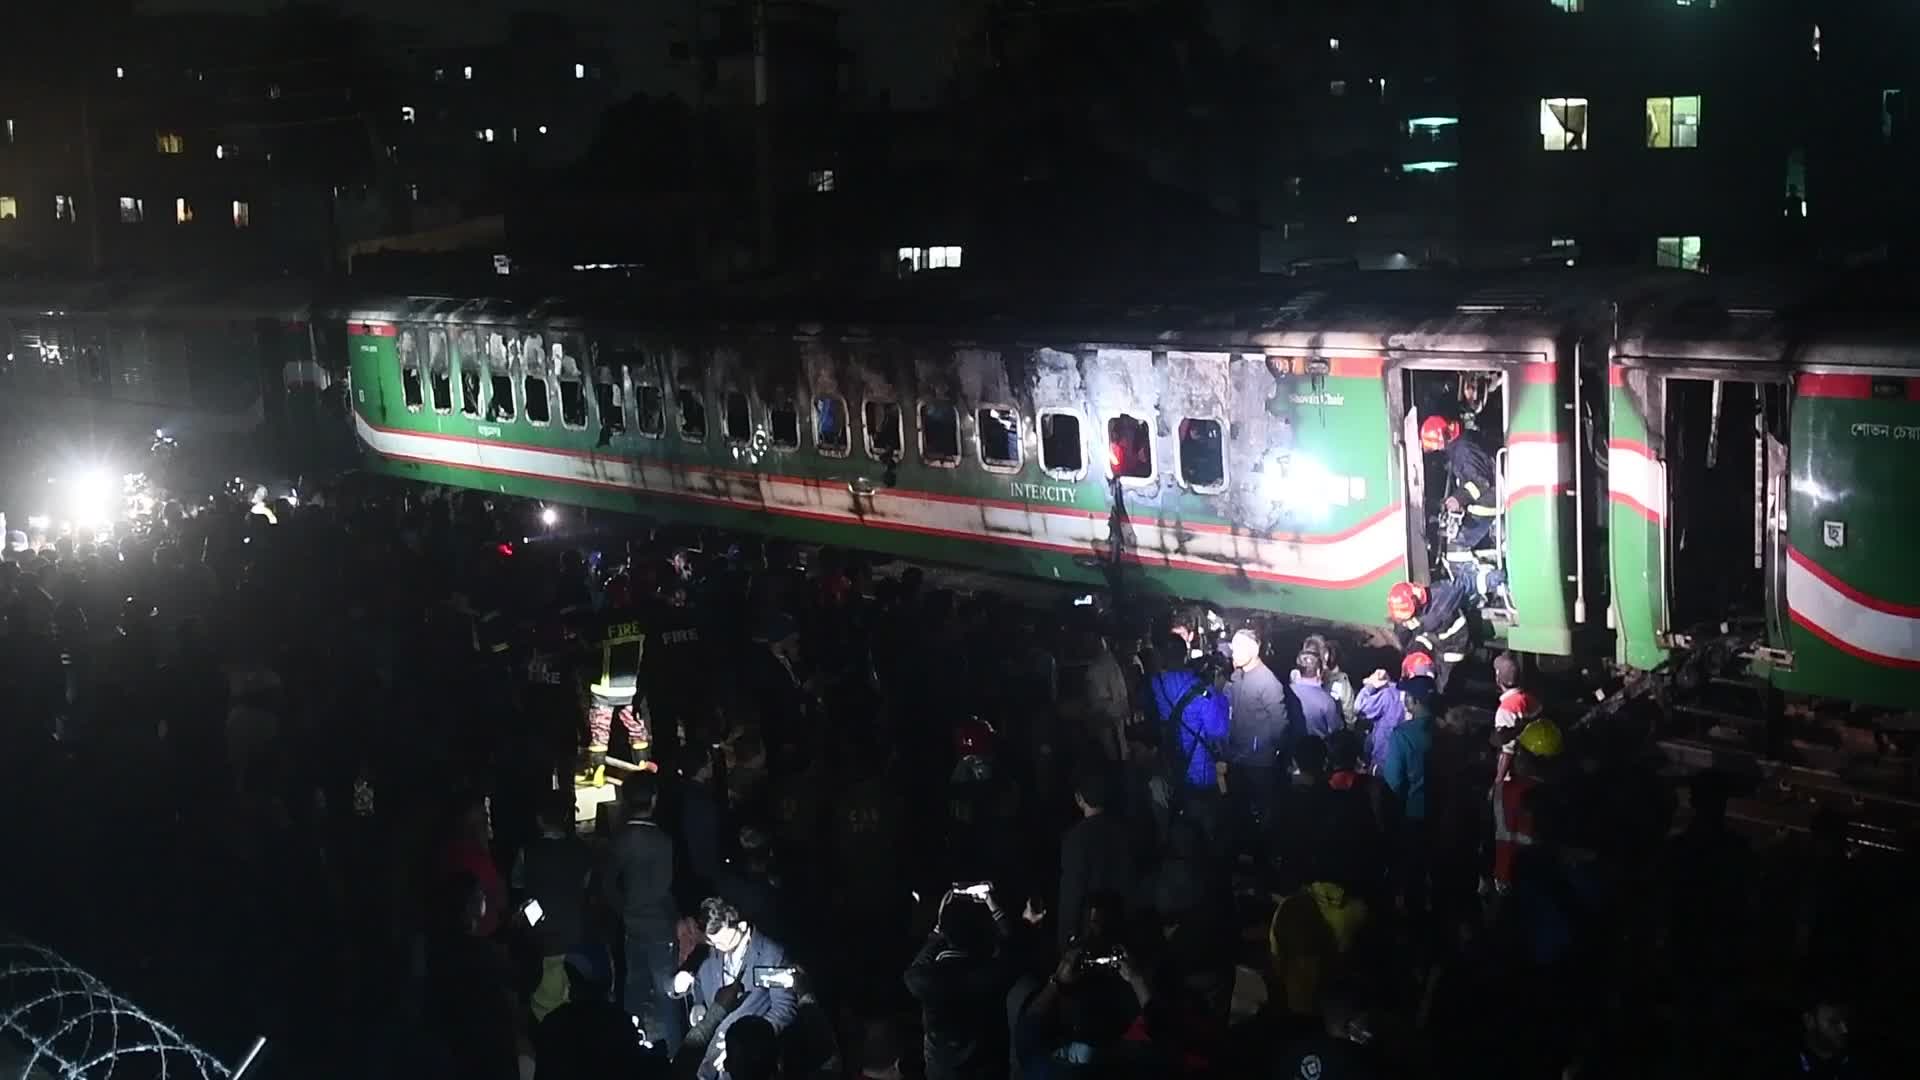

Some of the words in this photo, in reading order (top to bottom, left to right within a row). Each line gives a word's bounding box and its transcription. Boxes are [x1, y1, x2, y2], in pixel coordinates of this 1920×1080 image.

[1893, 425, 1920, 441] চেয়া
[1010, 482, 1077, 503] INTERCITY
[608, 623, 640, 638] FIRE
[661, 628, 698, 645] FIRE
